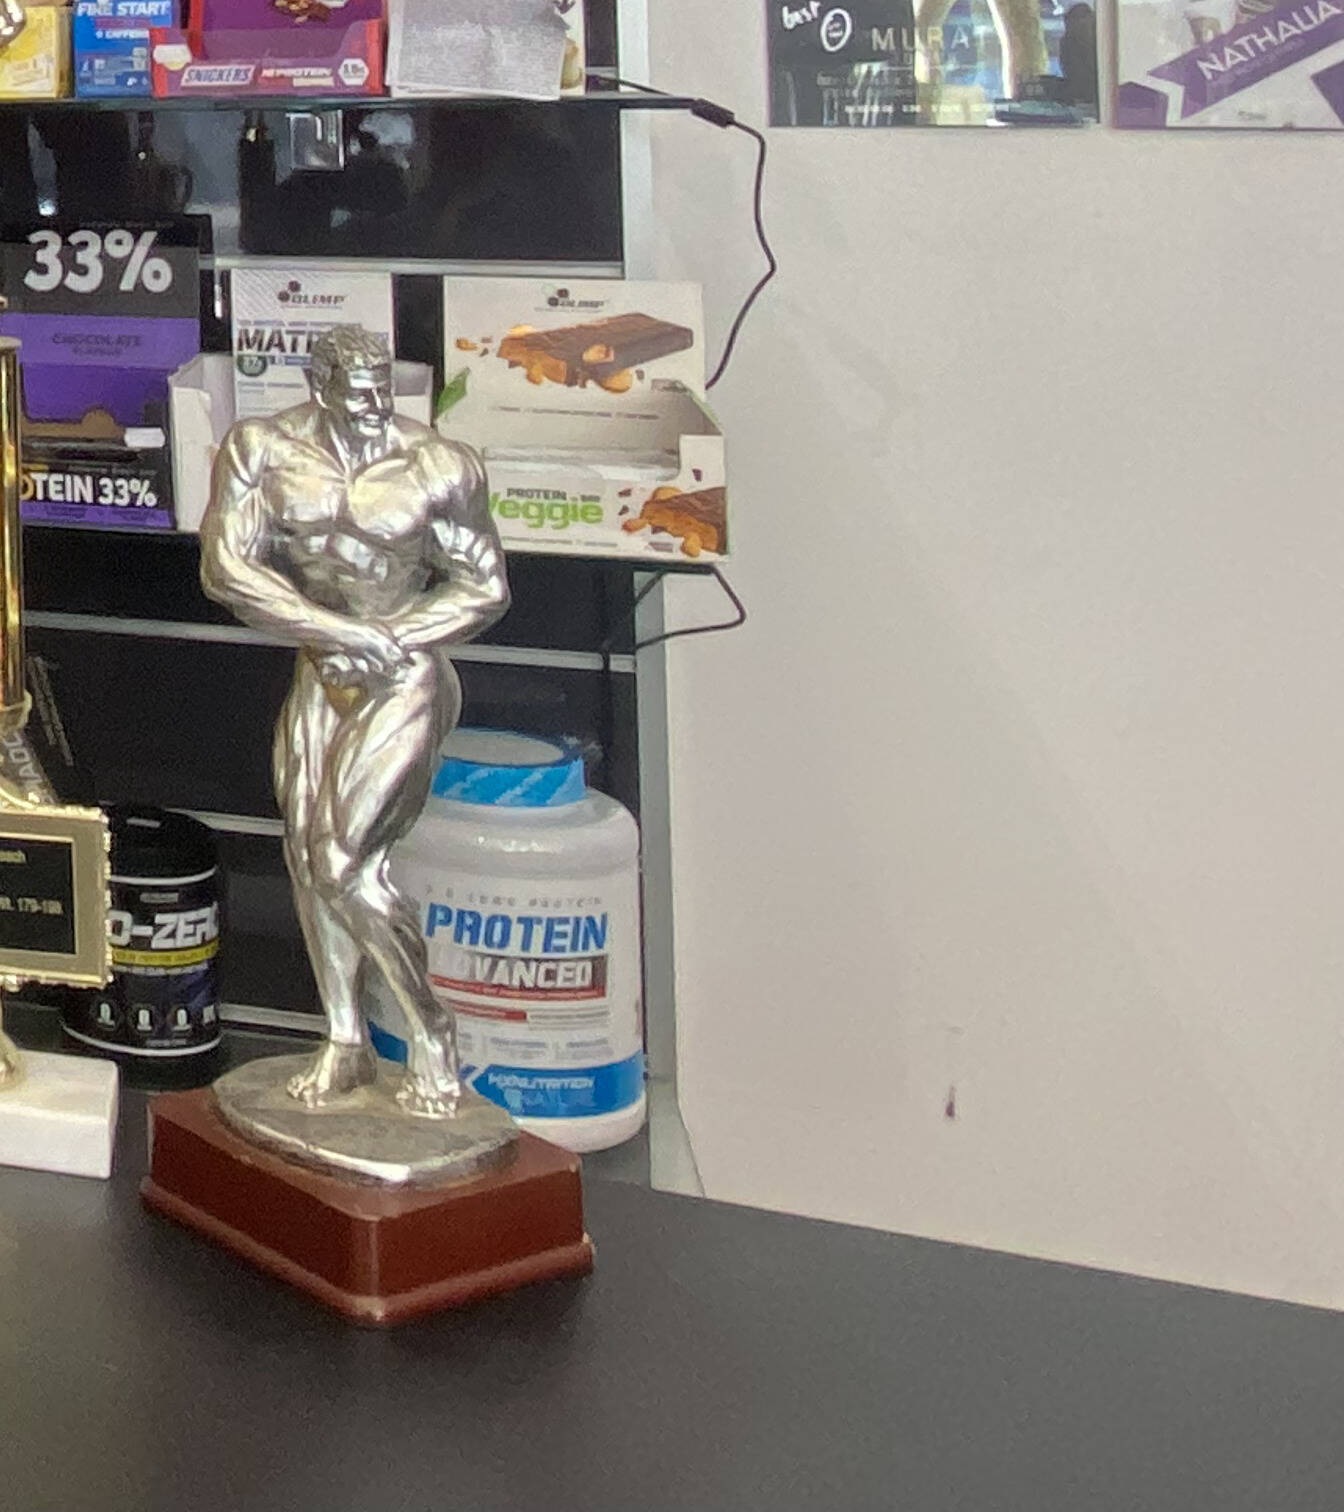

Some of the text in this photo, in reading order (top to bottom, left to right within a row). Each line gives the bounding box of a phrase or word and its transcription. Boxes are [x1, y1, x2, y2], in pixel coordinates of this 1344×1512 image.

[117, 1, 170, 16] START
[1196, 0, 1343, 80] NATHALIA
[185, 66, 251, 85] SNICKERS
[23, 228, 173, 294] 33%
[237, 327, 314, 354] MAT
[20, 472, 158, 507] OTEIN 33%
[506, 488, 567, 501] PROTEIN
[425, 902, 609, 954] PROTEIN
